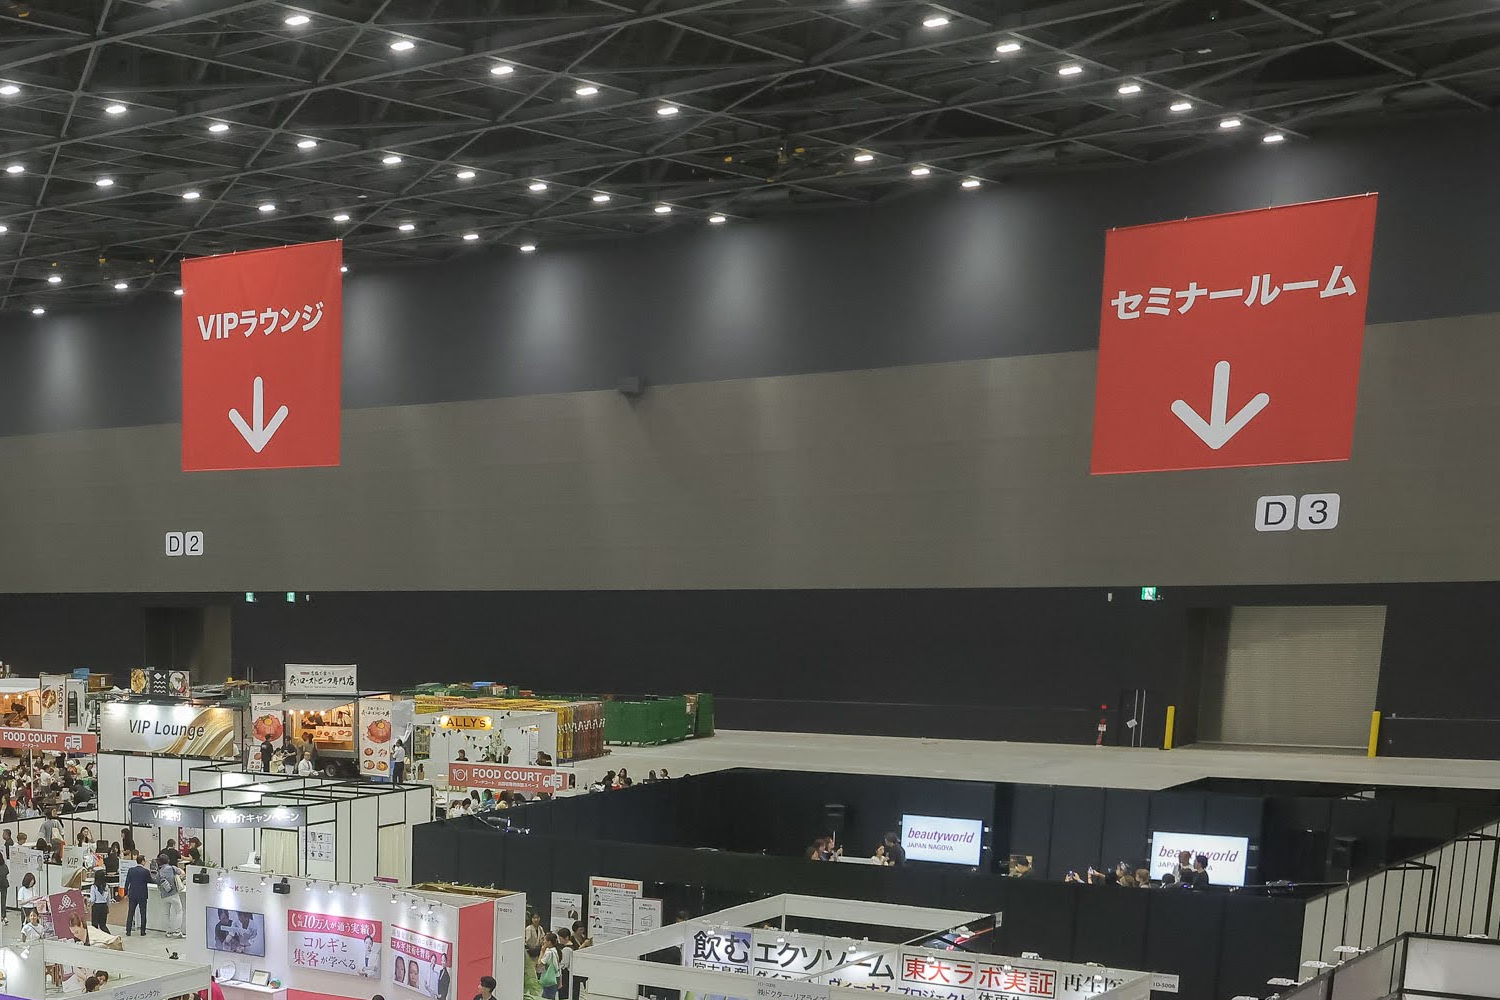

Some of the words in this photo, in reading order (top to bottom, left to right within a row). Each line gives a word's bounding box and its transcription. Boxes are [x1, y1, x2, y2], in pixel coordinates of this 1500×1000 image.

[1111, 265, 1357, 320] セミナールーム
[197, 302, 324, 341] VIPラウンジ
[3, 731, 26, 743] FOOD
[28, 733, 58, 744] COURT
[129, 719, 151, 735] VIP
[155, 720, 205, 739] Lounge
[472, 768, 501, 780] FOOD
[503, 770, 542, 782] COURT
[907, 826, 975, 844] beautyworld
[906, 842, 927, 850] JAPAN
[928, 843, 954, 852] NAGOYA
[304, 936, 347, 952] コルギと
[293, 948, 356, 970] 集客が学べる
[904, 957, 1054, 995] 東大ラボ実証
